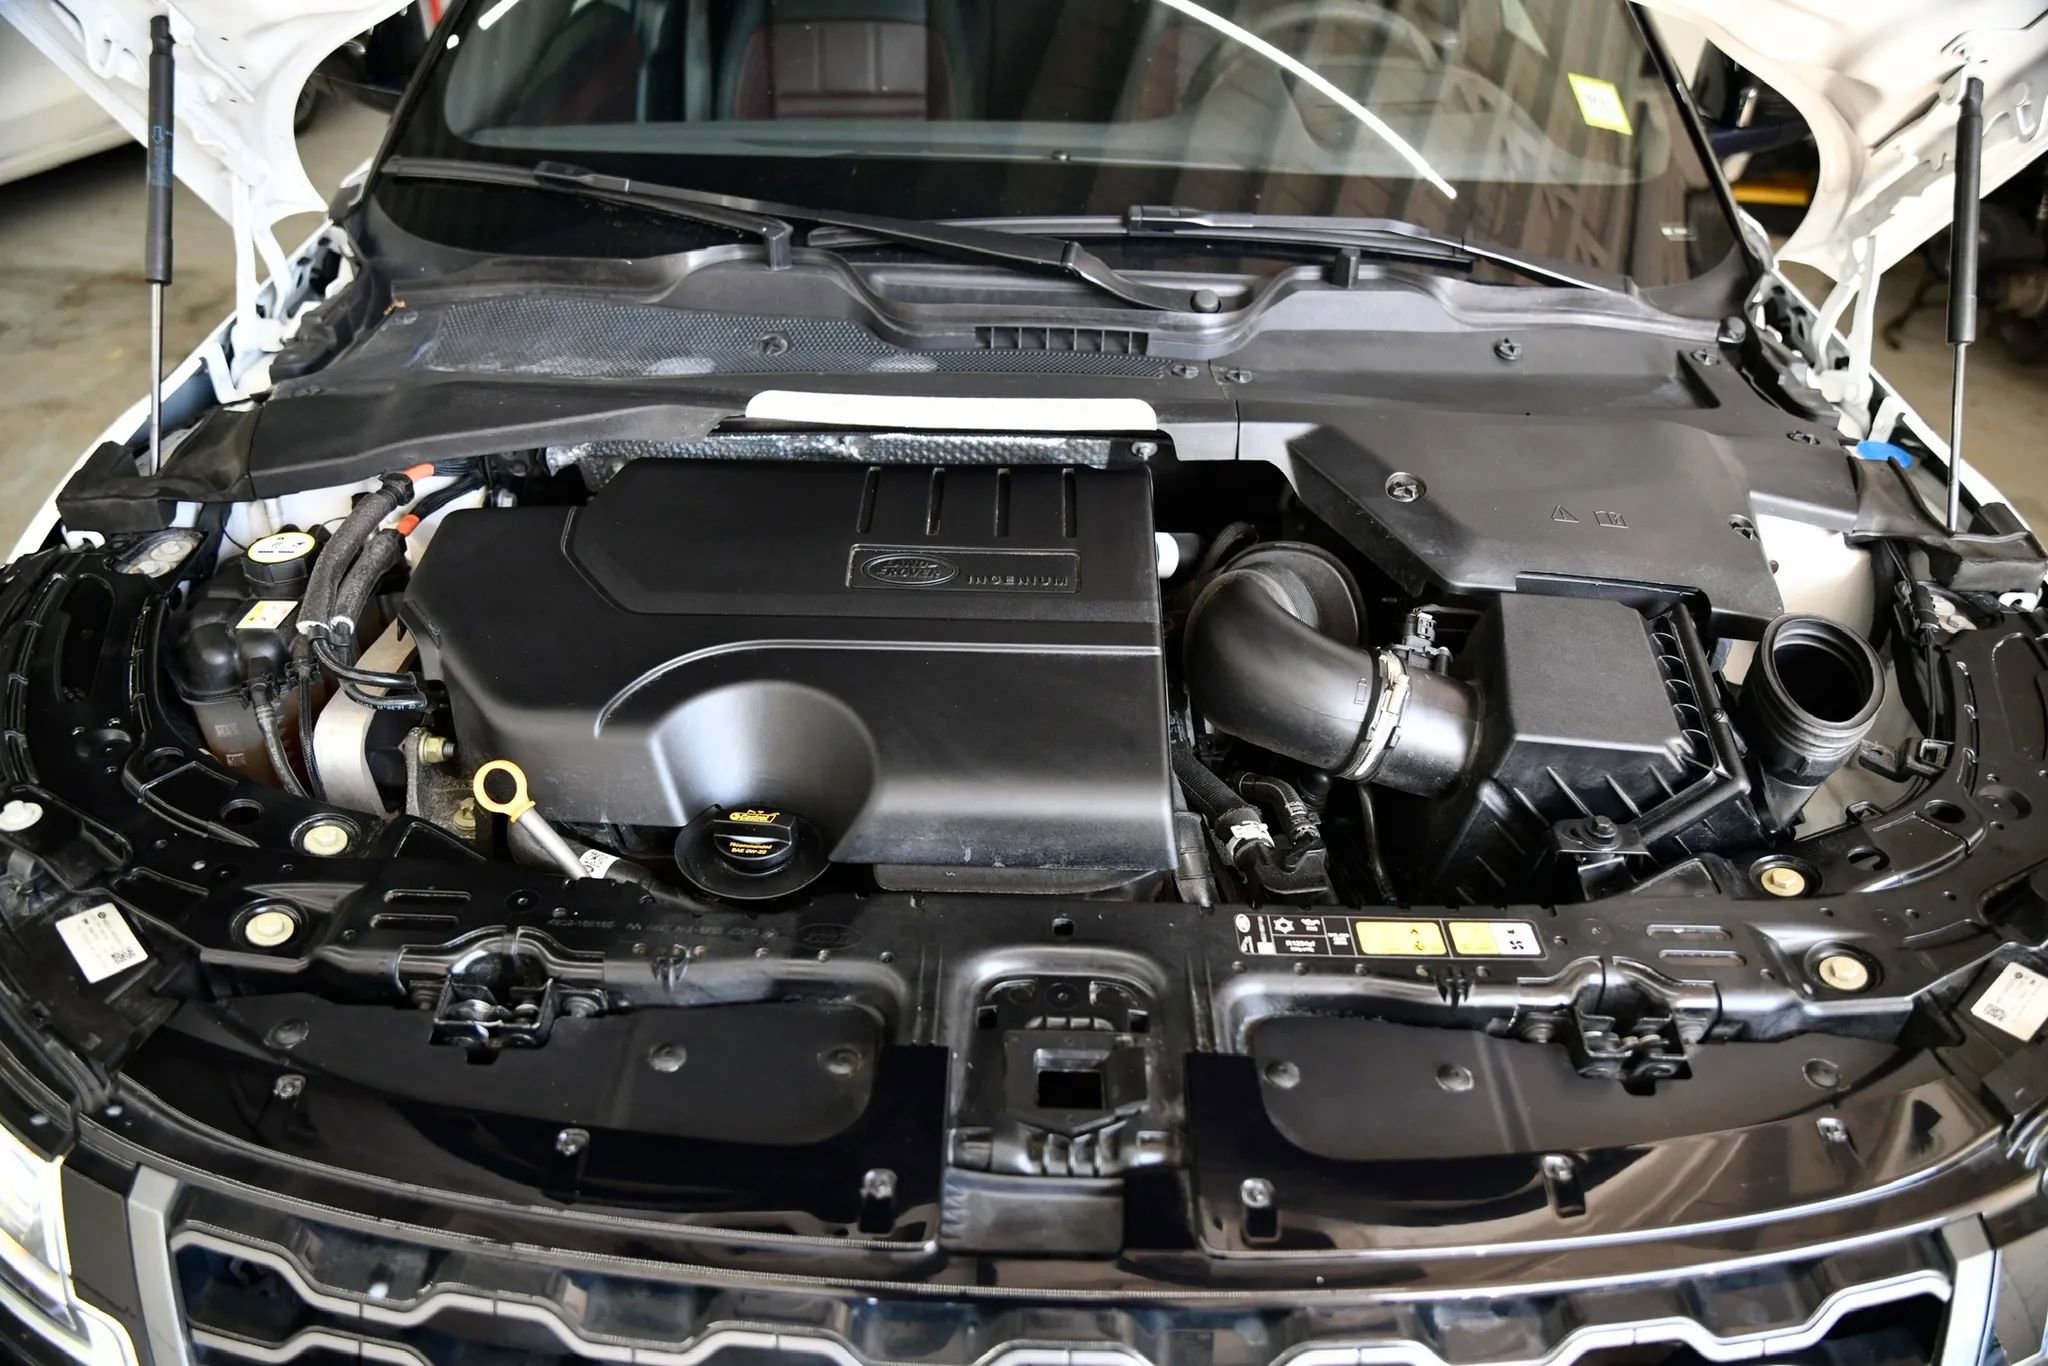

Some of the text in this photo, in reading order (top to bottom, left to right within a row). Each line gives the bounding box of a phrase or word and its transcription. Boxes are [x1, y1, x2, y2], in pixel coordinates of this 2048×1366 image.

[884, 567, 941, 579] ROVER
[967, 575, 1069, 586] INGENIUM
[729, 841, 772, 849] Recommended
